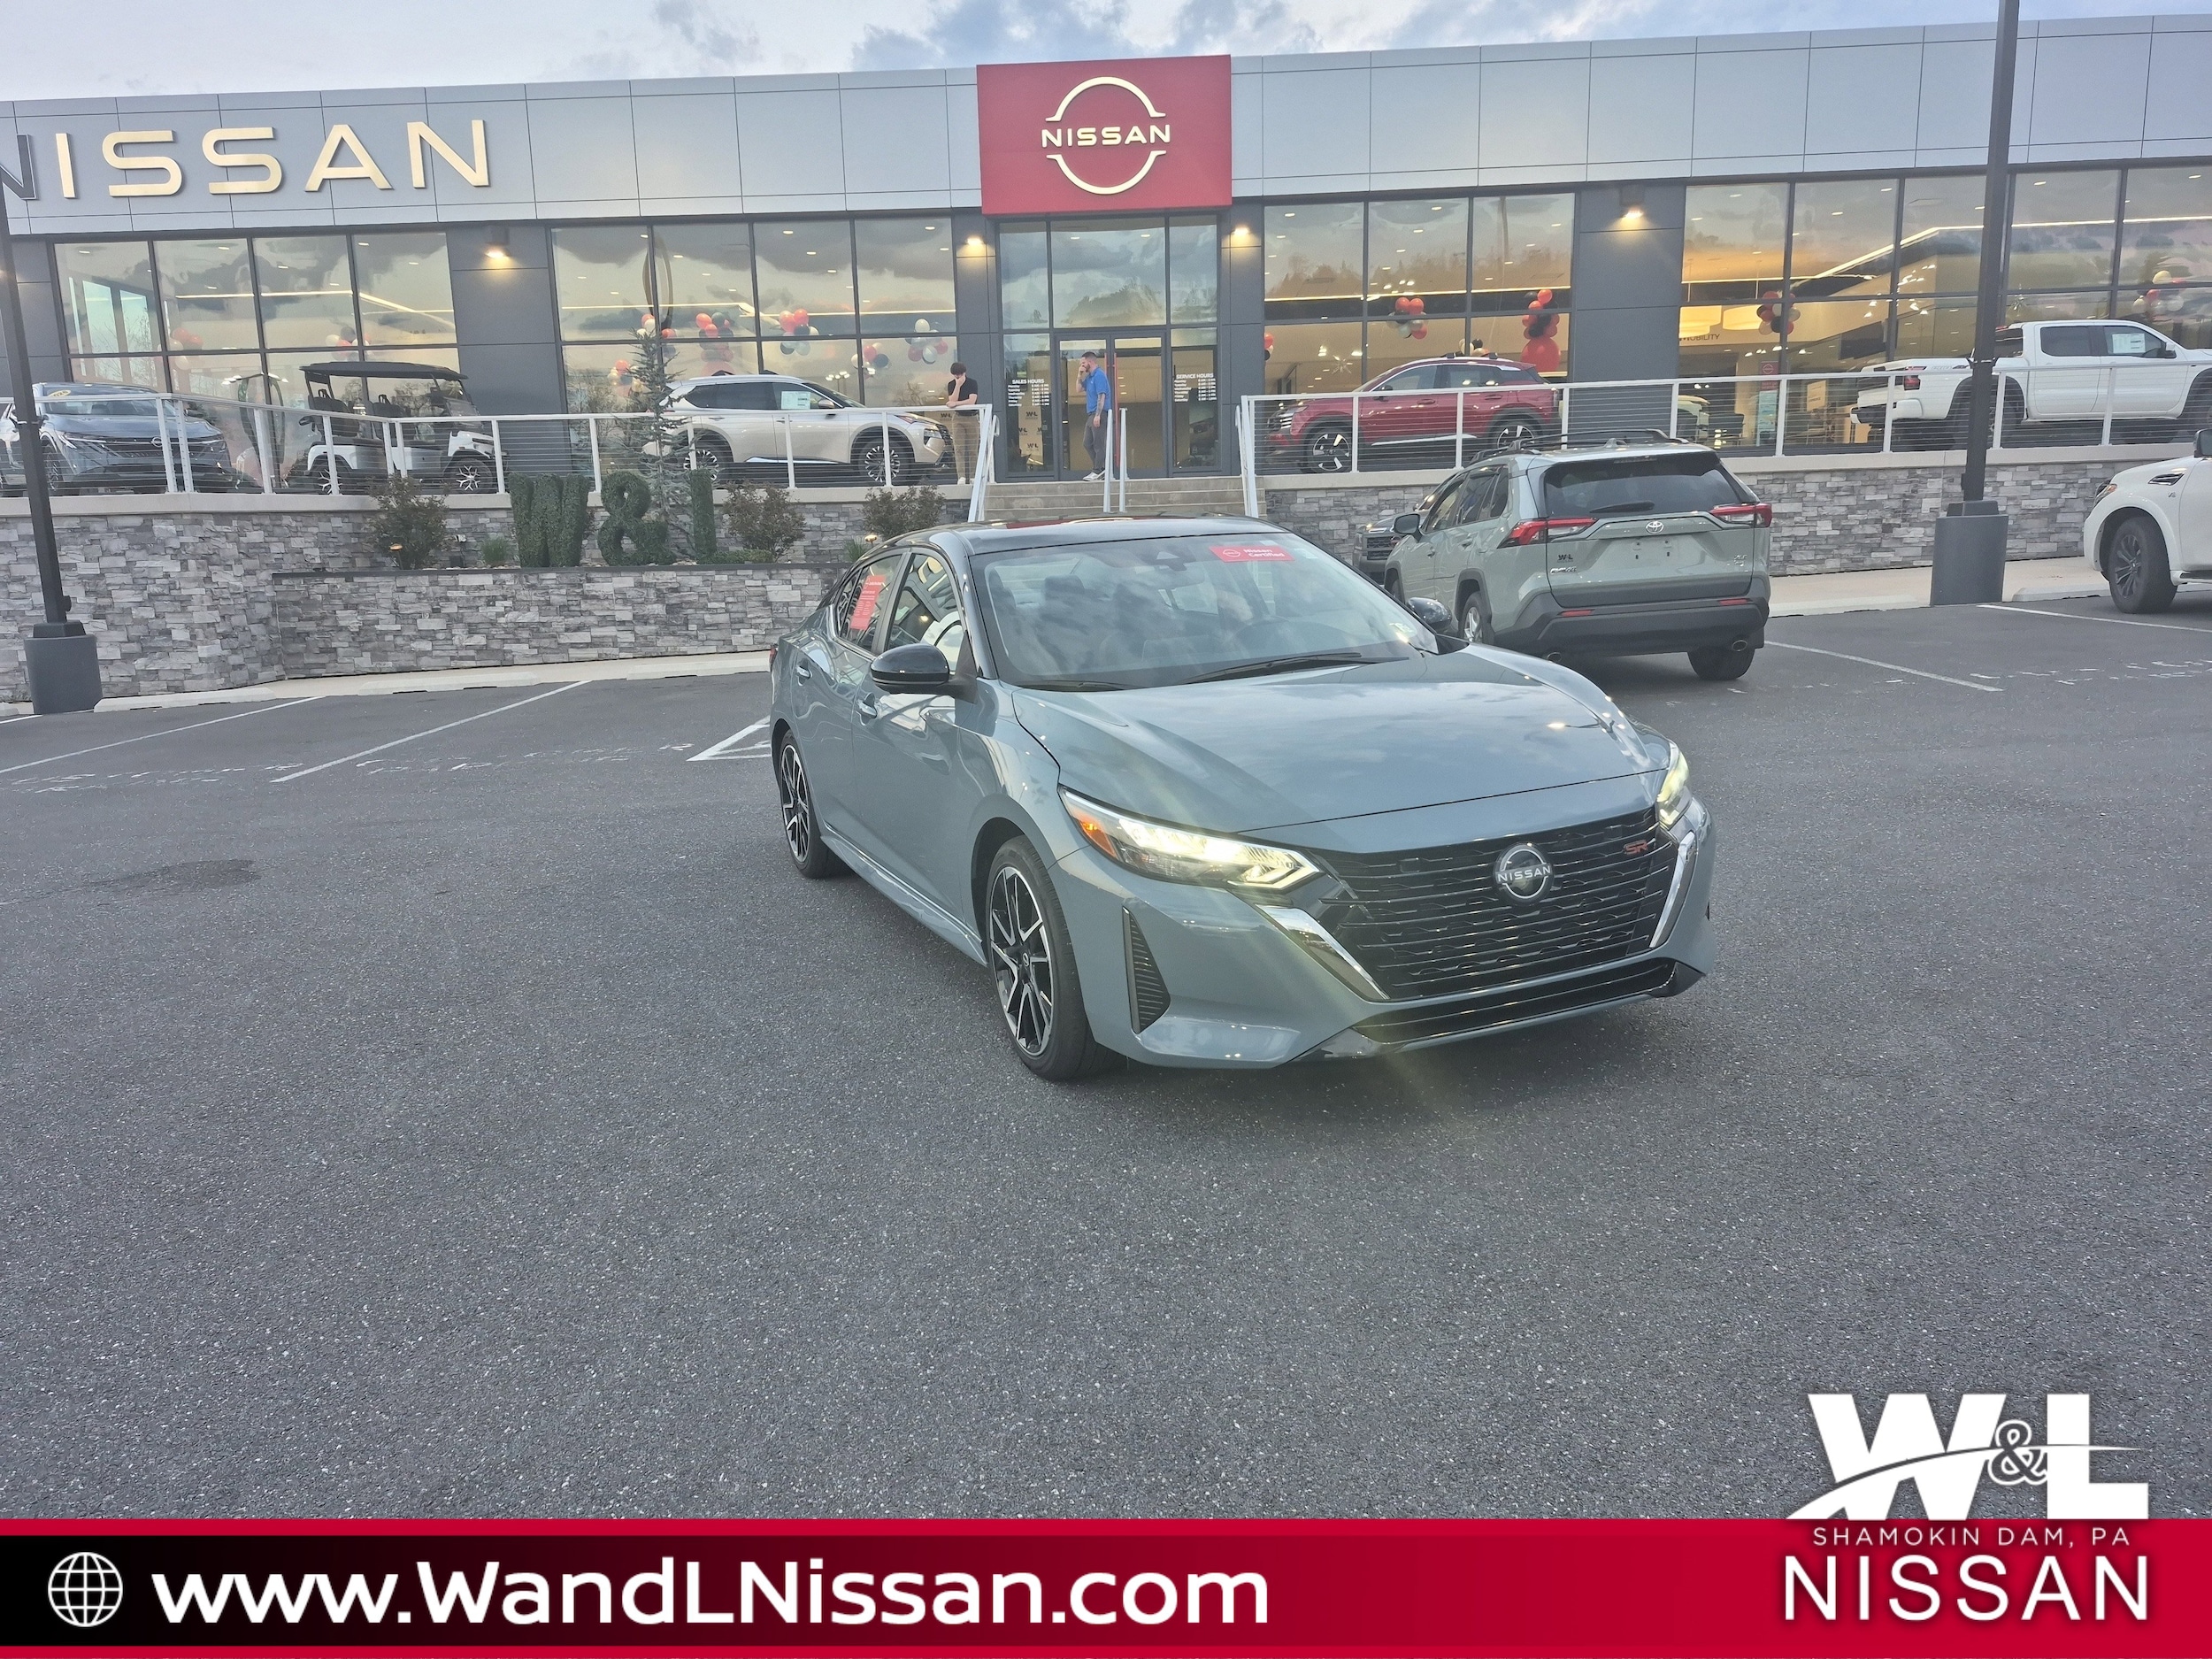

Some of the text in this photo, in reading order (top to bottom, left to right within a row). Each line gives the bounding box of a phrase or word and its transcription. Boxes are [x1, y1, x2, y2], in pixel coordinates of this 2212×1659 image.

[1041, 124, 1171, 148] NISSAN
[1624, 840, 1648, 856] SR
[1497, 864, 1551, 882] NISSAN
